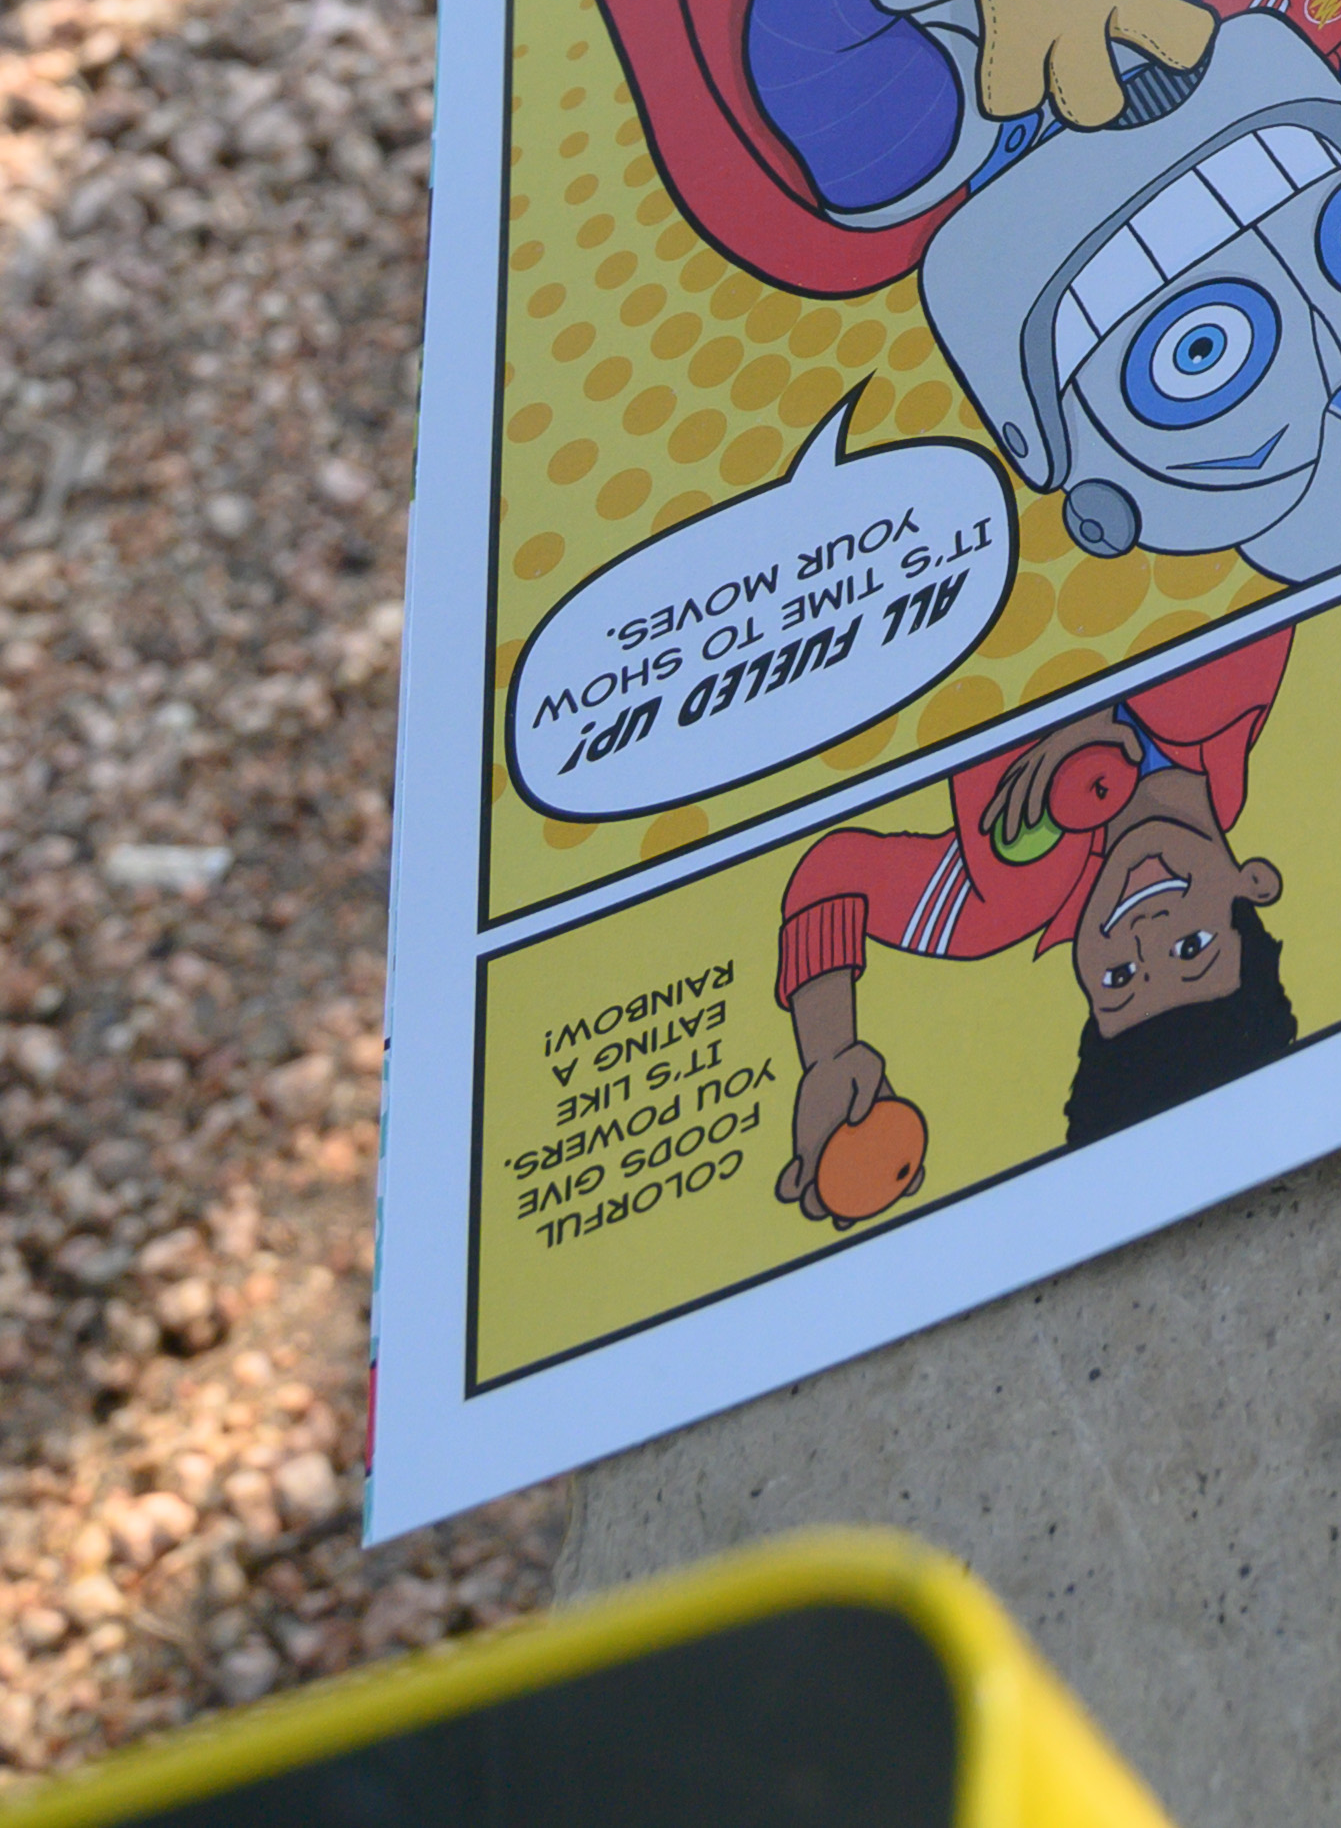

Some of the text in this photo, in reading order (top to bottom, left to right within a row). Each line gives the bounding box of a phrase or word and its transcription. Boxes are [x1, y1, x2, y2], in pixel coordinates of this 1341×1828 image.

[532, 517, 992, 729] IT'S TIME TO SHOW
[605, 507, 920, 646] YOUR MOVES.
[559, 569, 969, 775] ALL FUELED UP!
[543, 959, 735, 1056] RAINBOW!
[552, 1000, 727, 1087] EATING A
[503, 1057, 777, 1175] YOU POWERS.
[555, 1039, 723, 1125] IT'S LIKE
[516, 1101, 762, 1218] FOODS GIVE
[535, 1148, 745, 1250] COLORFUL
